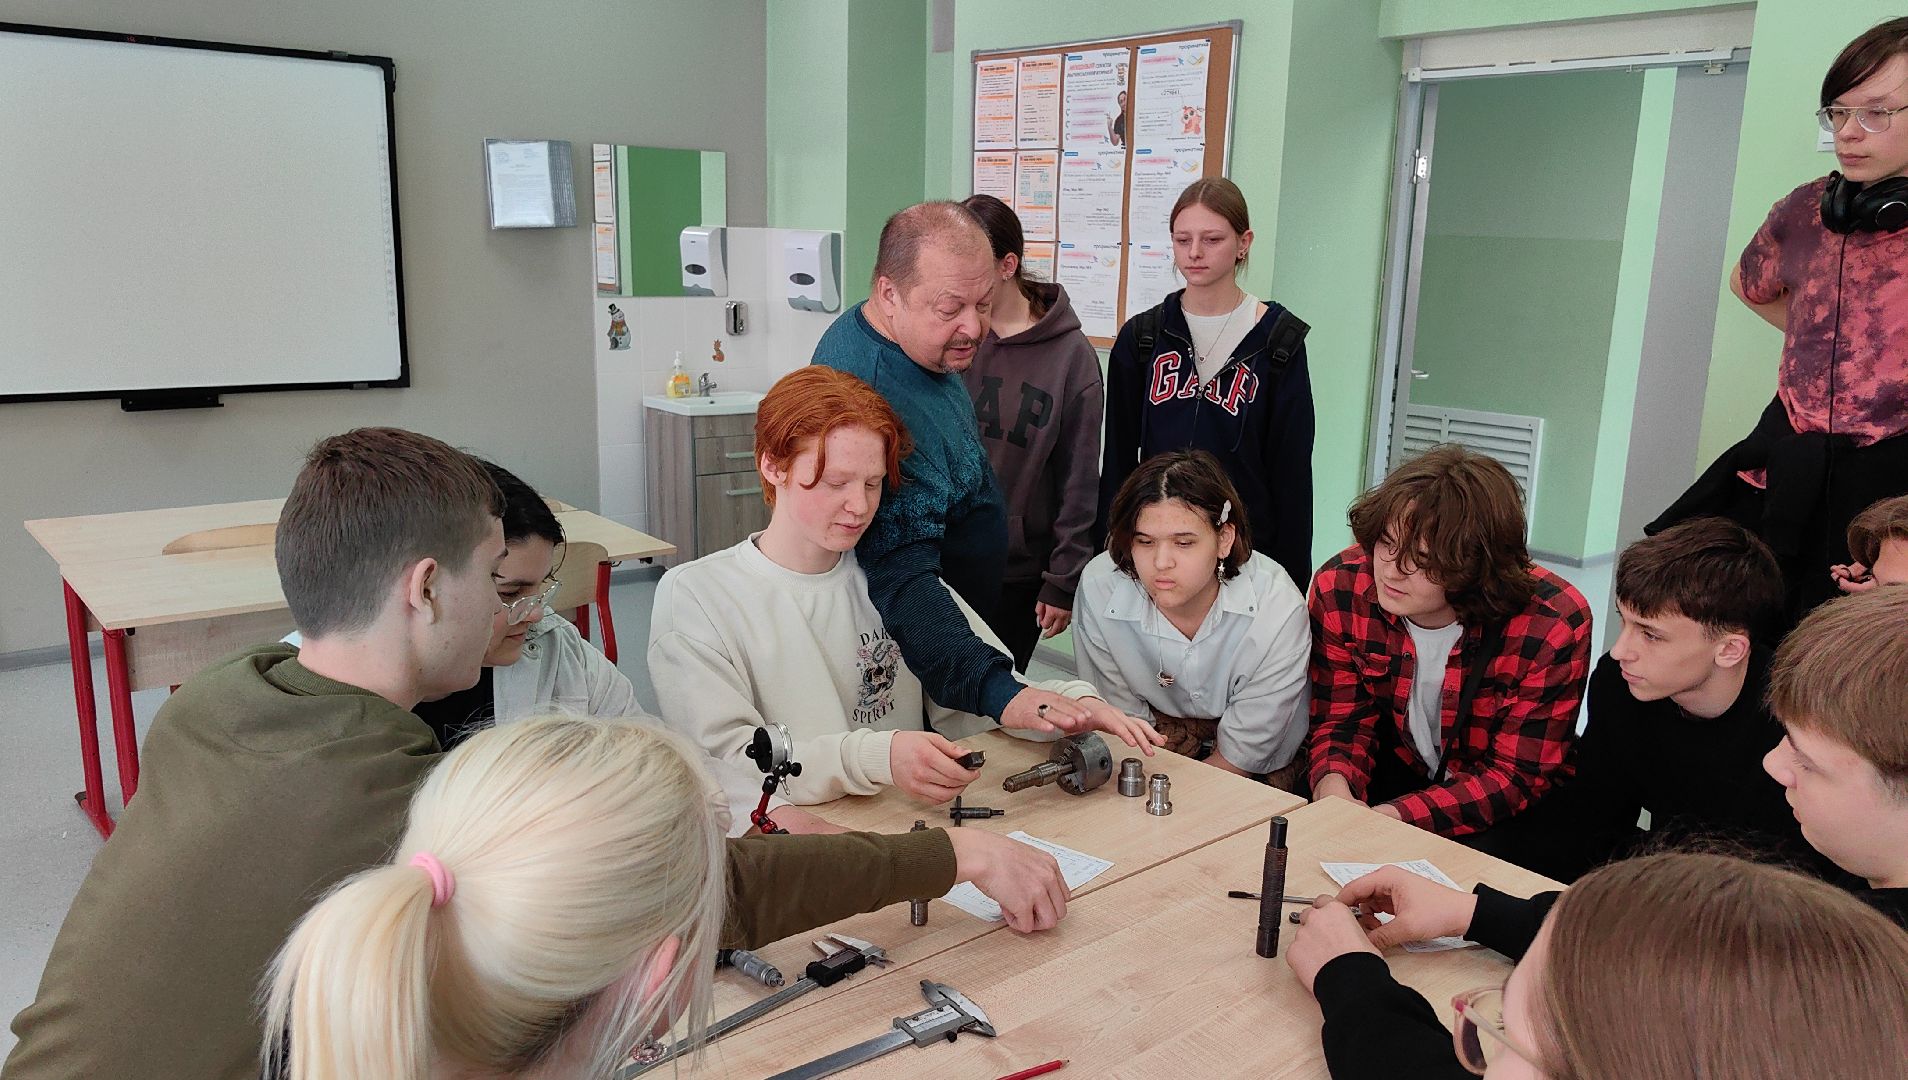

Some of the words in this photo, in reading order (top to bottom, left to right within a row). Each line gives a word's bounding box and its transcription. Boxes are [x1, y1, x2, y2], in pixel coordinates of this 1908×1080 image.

[1149, 350, 1260, 416] GAP
[974, 375, 1054, 449] AP
[859, 627, 890, 646] DAR
[852, 698, 896, 724] SPIRIT
